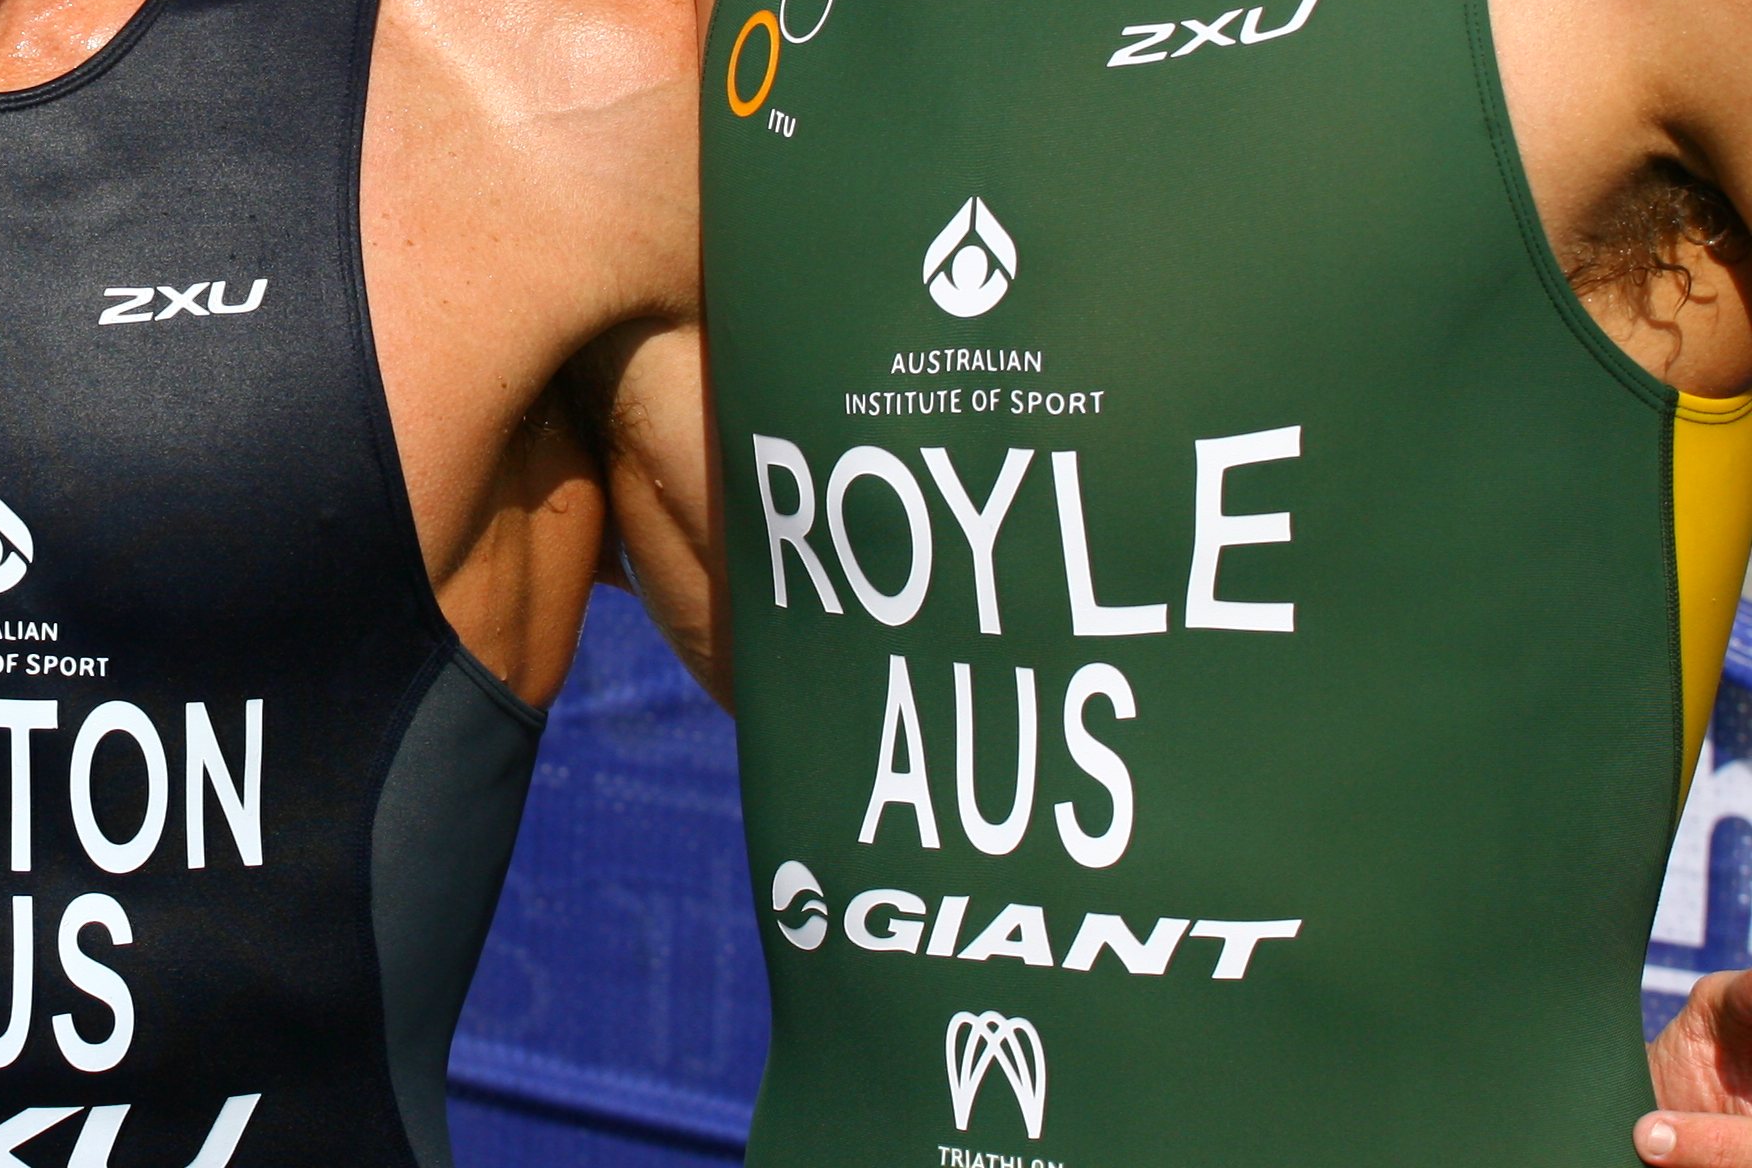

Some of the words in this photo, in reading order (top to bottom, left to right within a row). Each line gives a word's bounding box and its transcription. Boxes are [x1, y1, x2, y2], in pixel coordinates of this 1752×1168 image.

[768, 108, 796, 138] ITU
[98, 279, 268, 325] 2XU
[890, 348, 1043, 374] AUSTRALIAN
[845, 388, 962, 416] INSTITUTE
[971, 388, 1001, 412] OF
[1010, 389, 1105, 415] SPORT
[752, 425, 1302, 637] ROYLE
[25, 653, 109, 677] SPORT
[857, 654, 1137, 869] AUS
[844, 888, 1303, 980] GIANT
